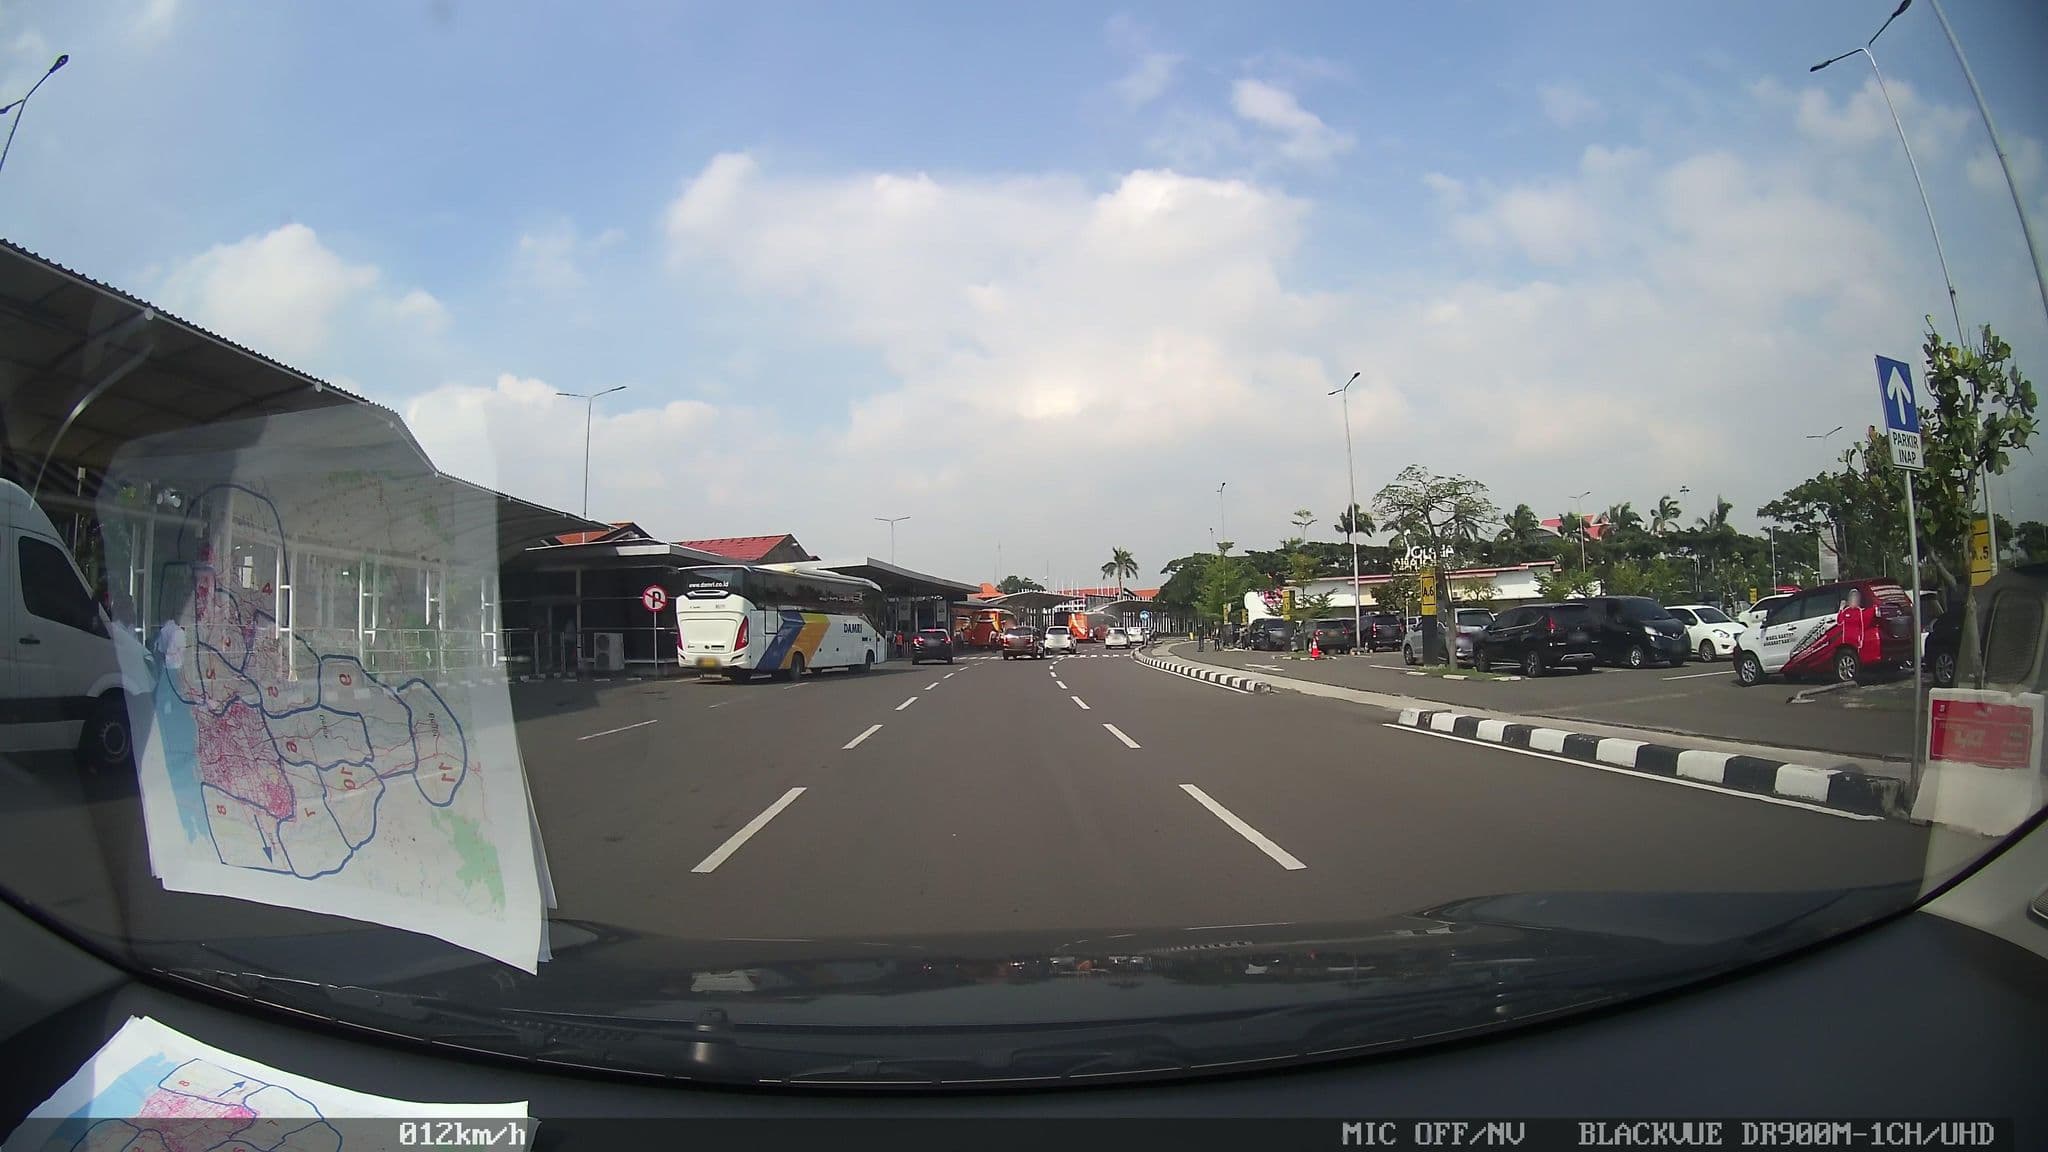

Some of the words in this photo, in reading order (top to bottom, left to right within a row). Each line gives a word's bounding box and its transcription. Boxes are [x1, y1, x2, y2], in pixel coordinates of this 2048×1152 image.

[1892, 432, 1919, 449] PARKIR
[1899, 449, 1917, 464] INAP
[1423, 586, 1434, 596] A.6
[652, 591, 661, 608] P
[843, 623, 862, 633] DAMRI
